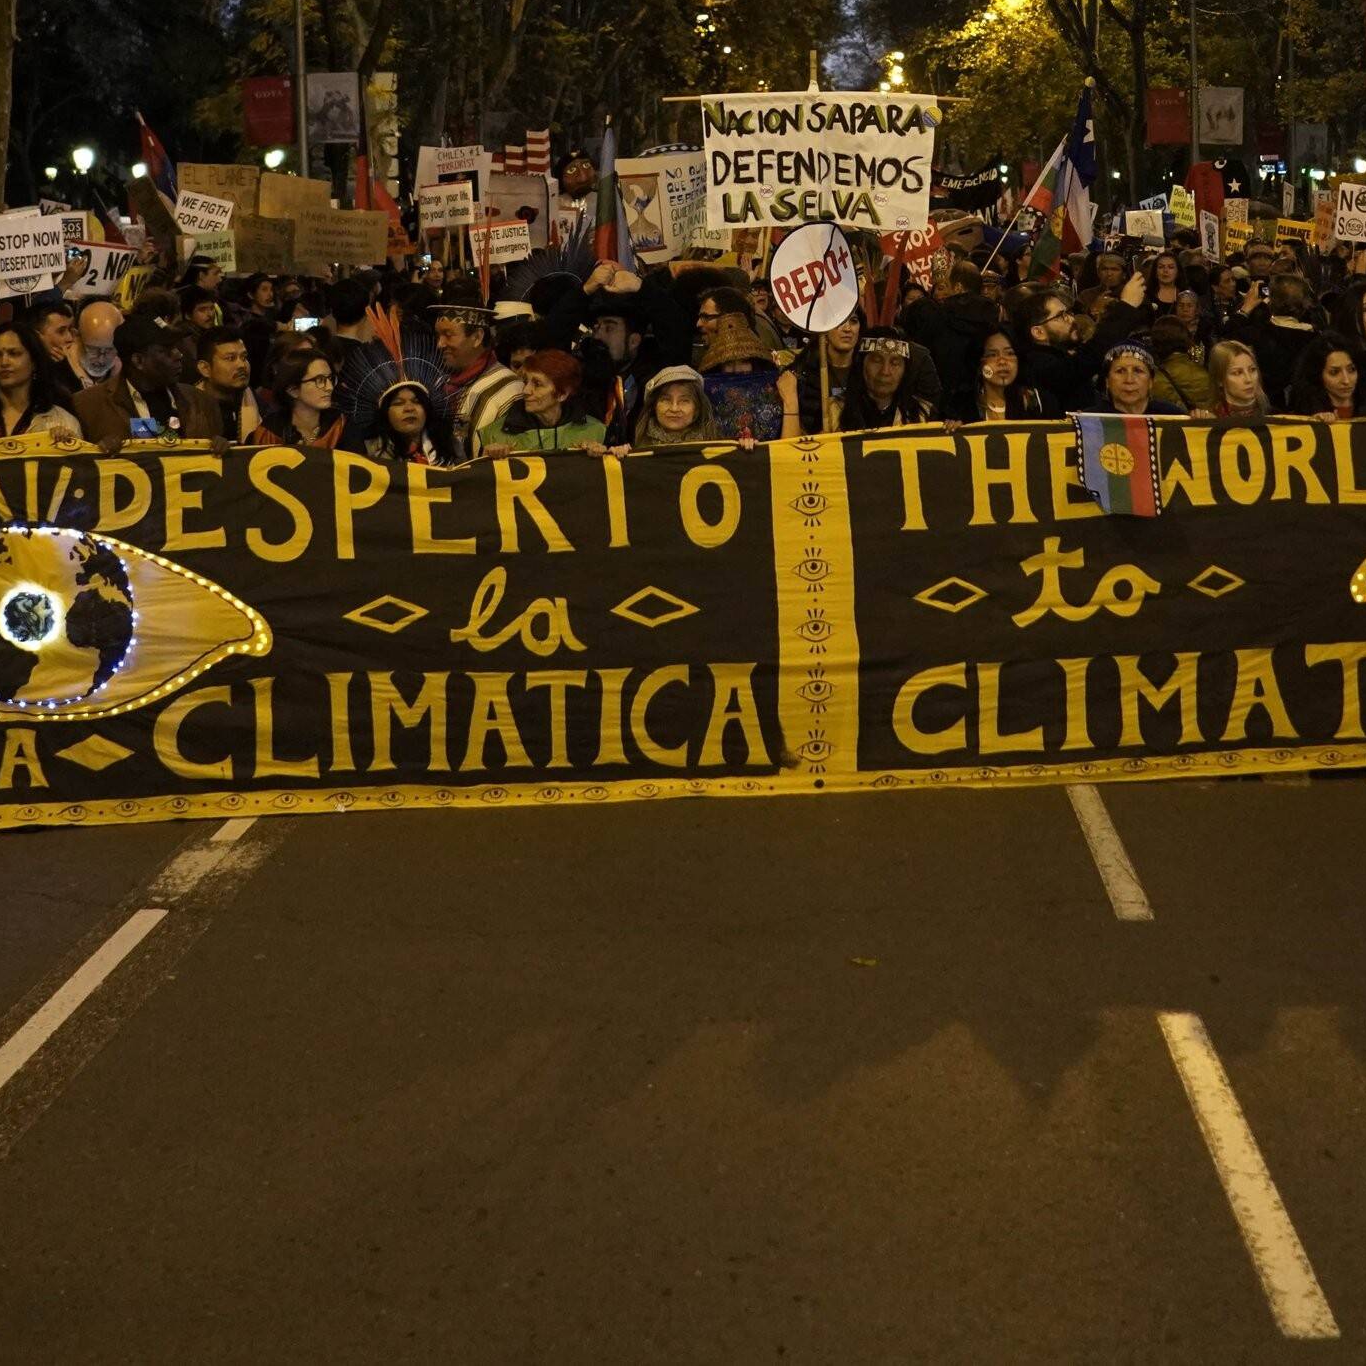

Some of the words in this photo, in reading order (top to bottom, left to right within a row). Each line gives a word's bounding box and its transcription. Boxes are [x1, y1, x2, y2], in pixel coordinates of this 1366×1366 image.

[704, 101, 803, 138] NACION
[807, 101, 927, 137] SAPARA
[667, 180, 686, 193] QUE
[712, 147, 924, 194] DEFENDEMOS
[177, 213, 198, 227] FOR
[198, 218, 225, 233] LIFE!
[181, 196, 199, 209] WE
[199, 201, 230, 218] FIGTH
[722, 190, 764, 224] LA
[770, 188, 882, 226] SELVA
[33, 230, 61, 247] NOW
[61, 222, 82, 233] SOS
[1277, 224, 1311, 239] CLIMATE
[0, 252, 63, 273] DESERTIZATION!
[772, 246, 849, 314] REDD+
[862, 429, 1105, 531] THE
[1010, 534, 1162, 628] to
[449, 565, 588, 654] la
[152, 661, 780, 782] CLIMATICA
